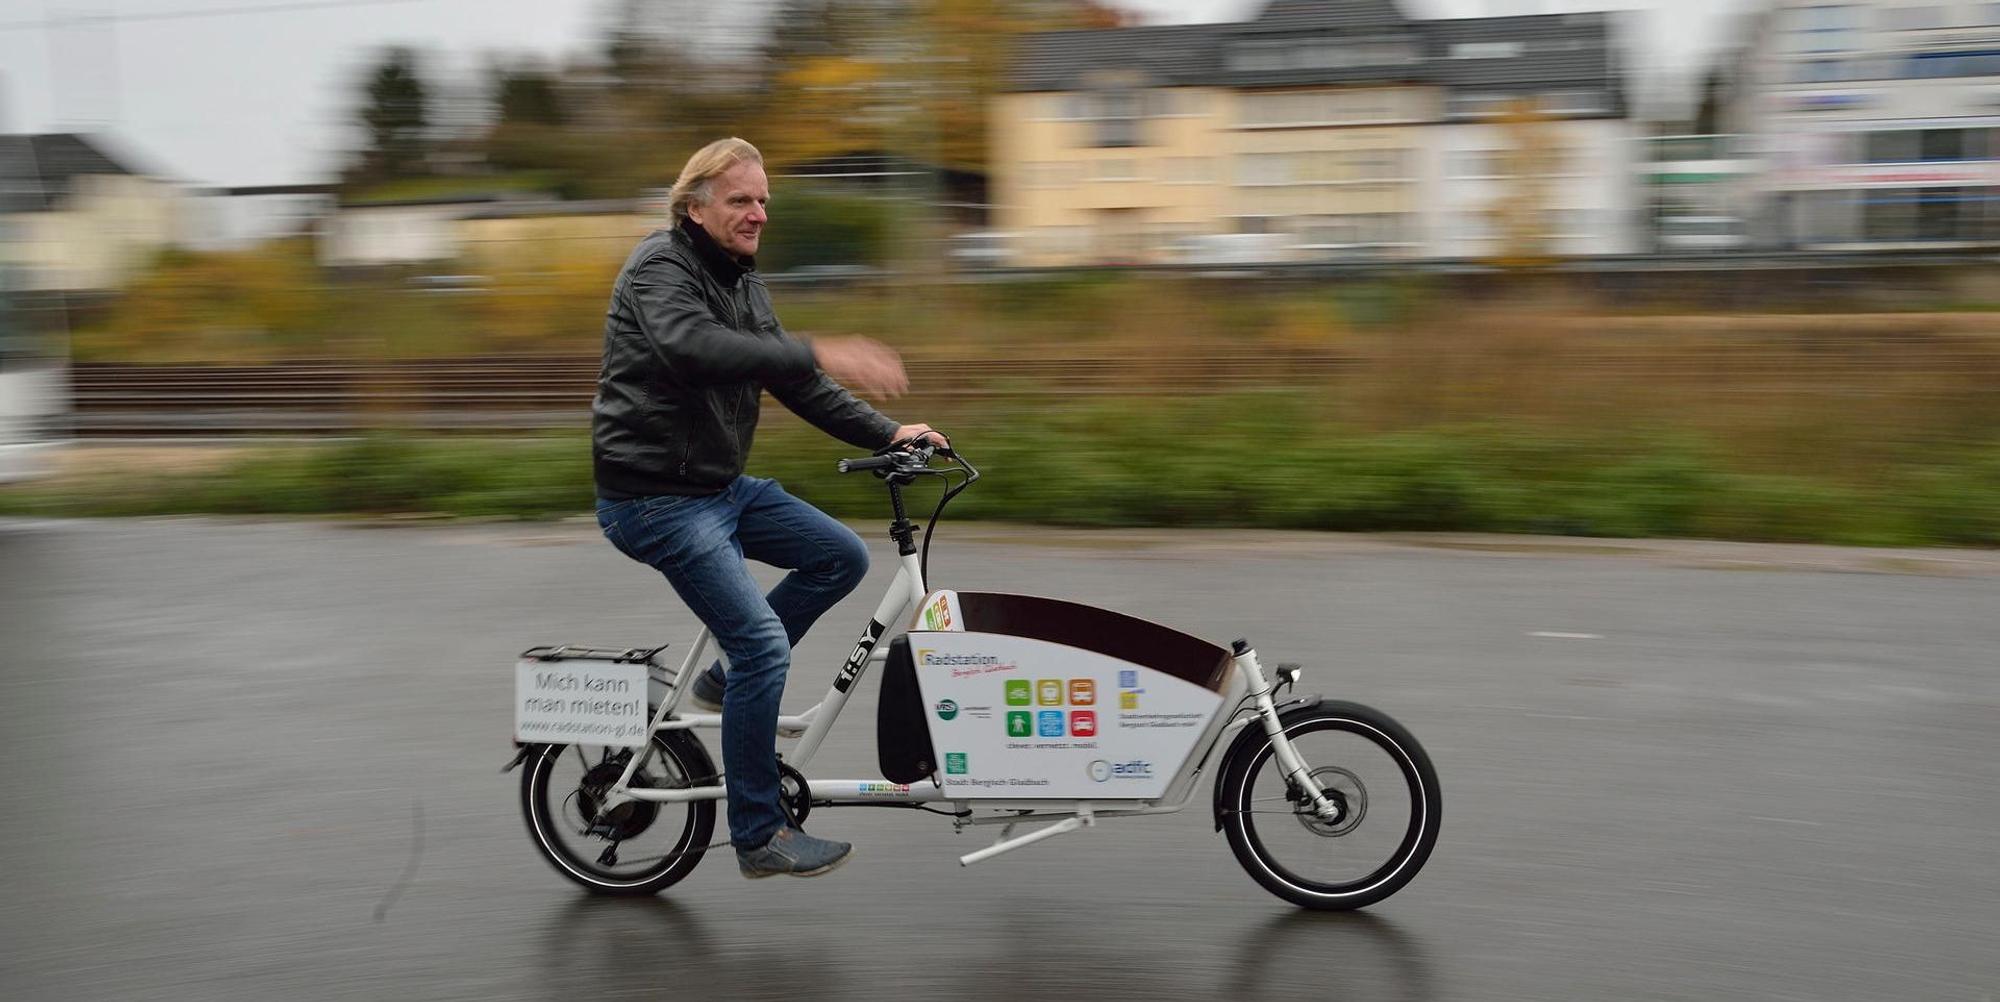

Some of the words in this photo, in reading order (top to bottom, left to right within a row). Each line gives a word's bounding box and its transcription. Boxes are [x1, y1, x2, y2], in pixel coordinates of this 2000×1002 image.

[925, 653, 998, 666] Radstation
[535, 672, 579, 691] Mich
[584, 673, 629, 693] kann
[524, 697, 565, 713] man
[570, 697, 640, 716] mieten!
[520, 720, 645, 738] www.radstation-gl.de
[1112, 760, 1152, 774] adfc
